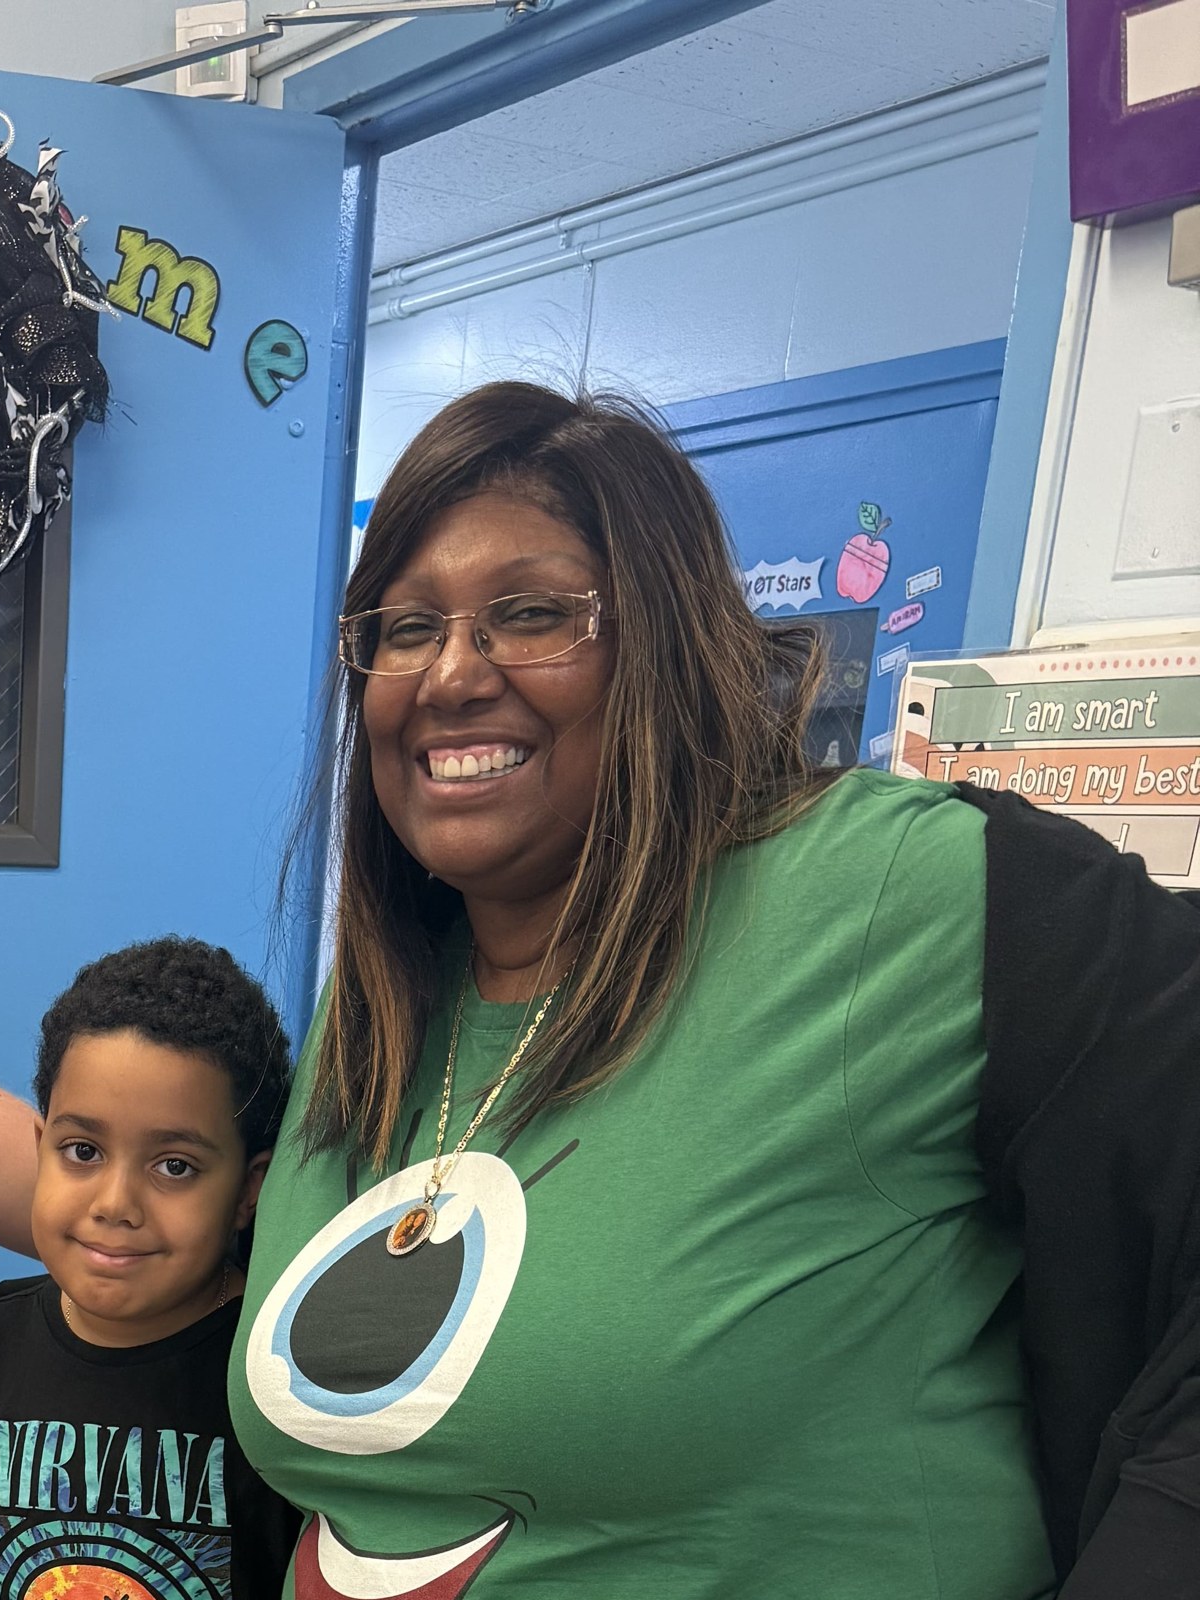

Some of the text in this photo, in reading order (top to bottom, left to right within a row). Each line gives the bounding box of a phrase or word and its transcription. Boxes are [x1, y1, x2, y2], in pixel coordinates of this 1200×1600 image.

[754, 575, 776, 595] OT
[776, 573, 812, 593] Stars
[1000, 690, 1159, 735] I am smart
[939, 755, 1200, 805] I am doing my best
